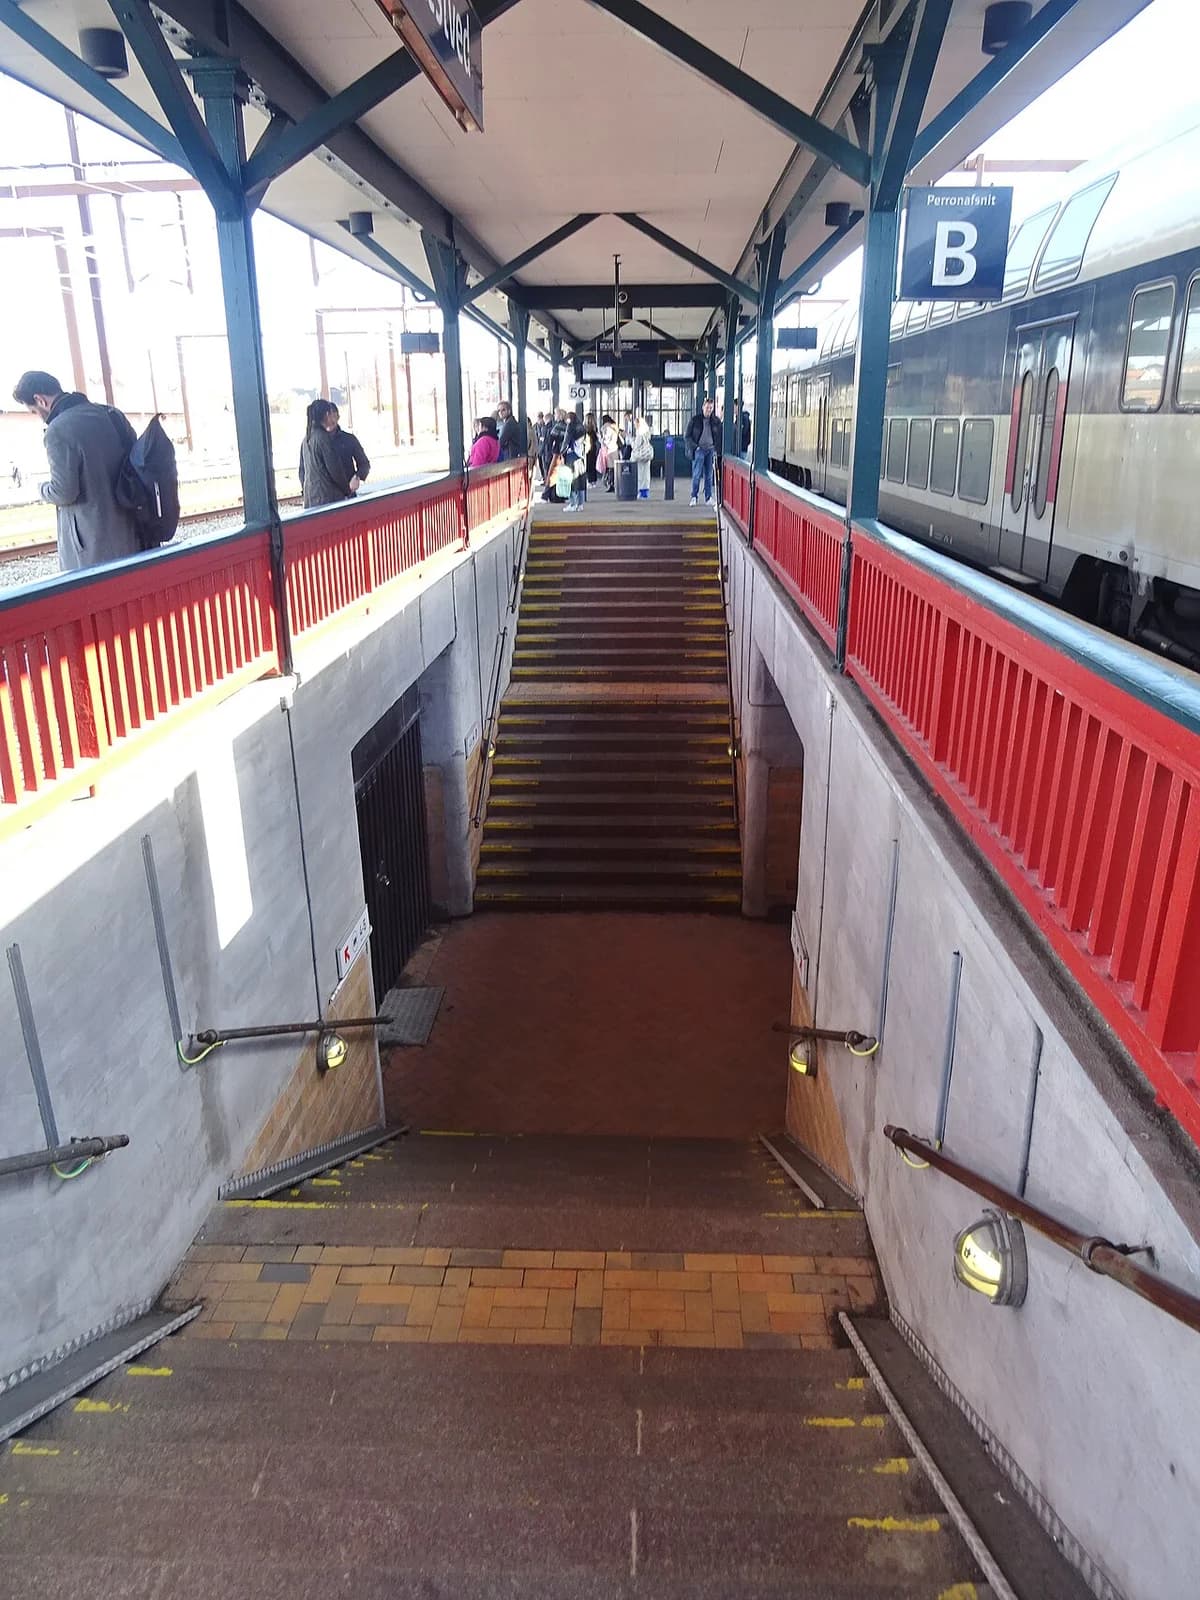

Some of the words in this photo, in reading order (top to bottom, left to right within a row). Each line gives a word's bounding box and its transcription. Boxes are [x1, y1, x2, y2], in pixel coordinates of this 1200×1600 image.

[927, 194, 996, 206] Perronafsnit
[932, 221, 978, 287] B
[570, 387, 586, 399] 50
